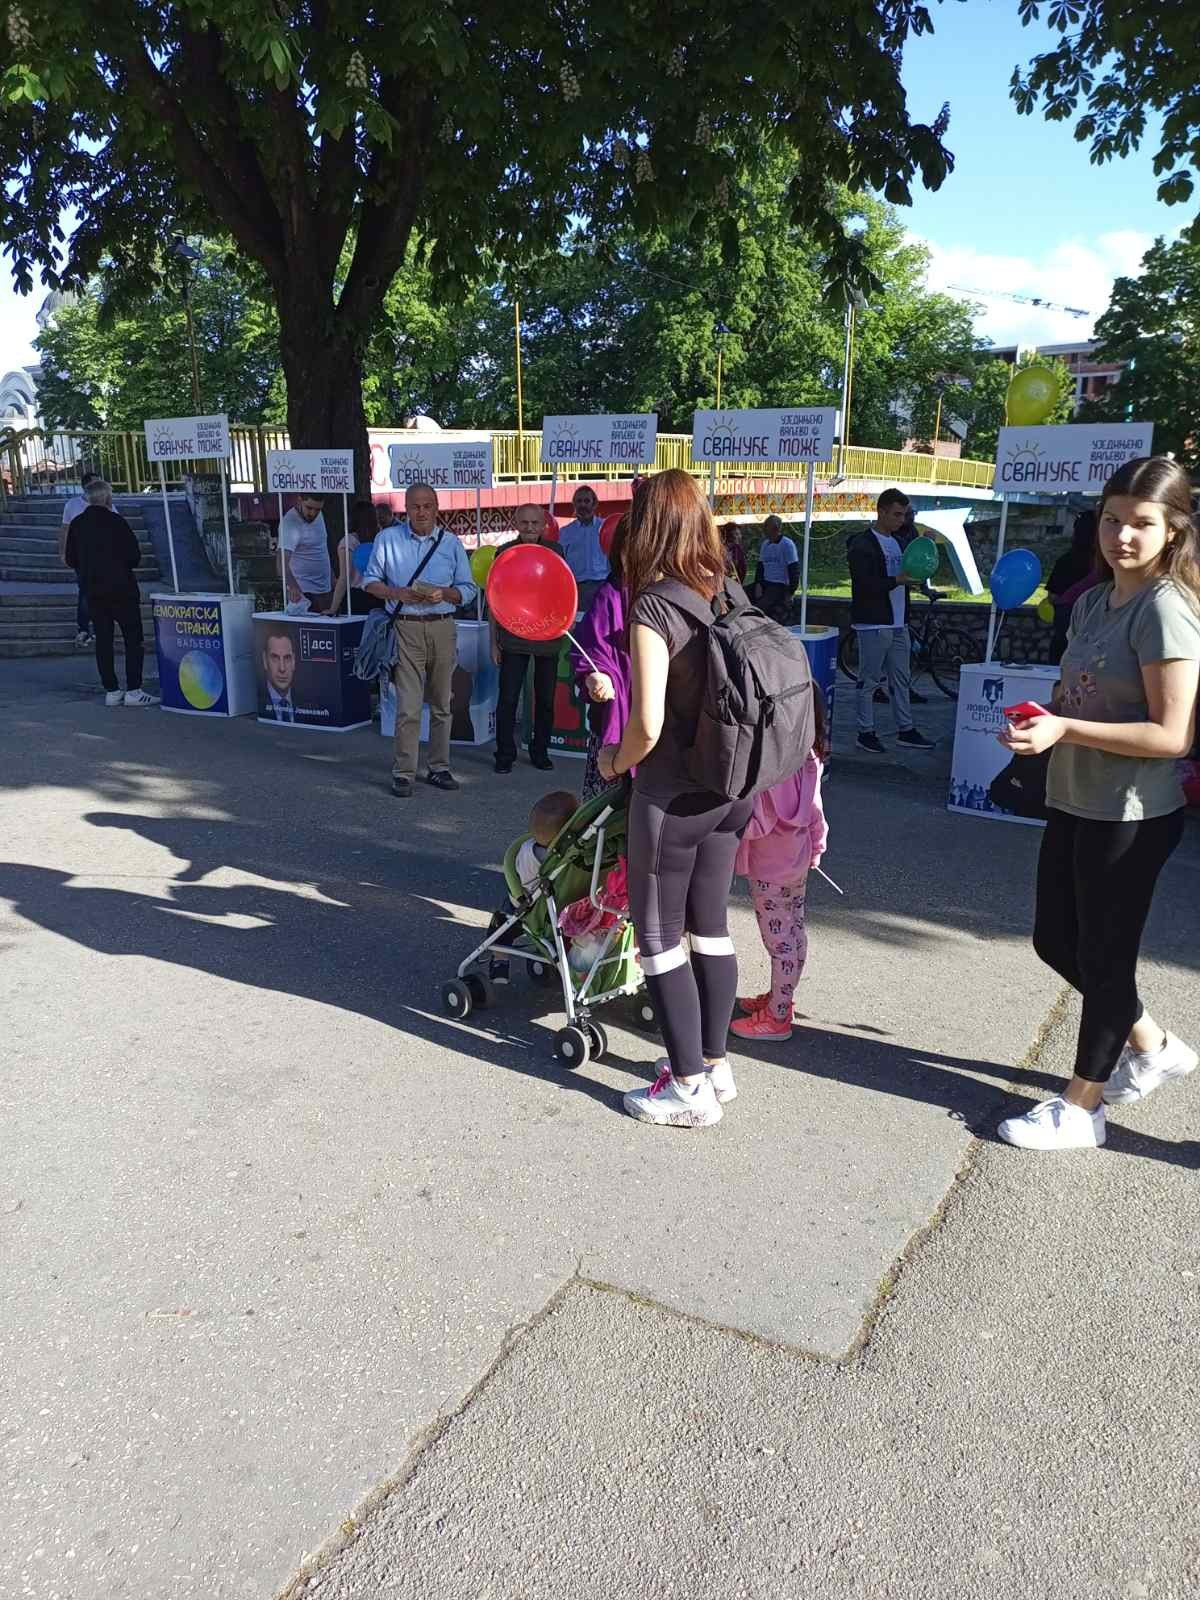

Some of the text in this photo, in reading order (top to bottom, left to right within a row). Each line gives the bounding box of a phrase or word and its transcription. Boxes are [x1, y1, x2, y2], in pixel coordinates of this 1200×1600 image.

[781, 414, 823, 425] УЈЕДИЊЕНО
[780, 427, 808, 436] ВАЉЕВО
[198, 439, 223, 453] МОЖЕ
[610, 441, 645, 458] МОЖЕ
[779, 438, 821, 456] МОЖЕ
[1092, 440, 1143, 450] УЈЕДИЊЕНО
[1090, 452, 1126, 461] ВАЉЕВО
[454, 469, 486, 484] МОЖЕ
[1088, 463, 1121, 481] МО
[321, 476, 350, 490] МОЖЕ
[175, 622, 219, 635] СТРАНКА
[176, 638, 220, 649] ВАЉЕВО
[311, 640, 333, 650] ДСС
